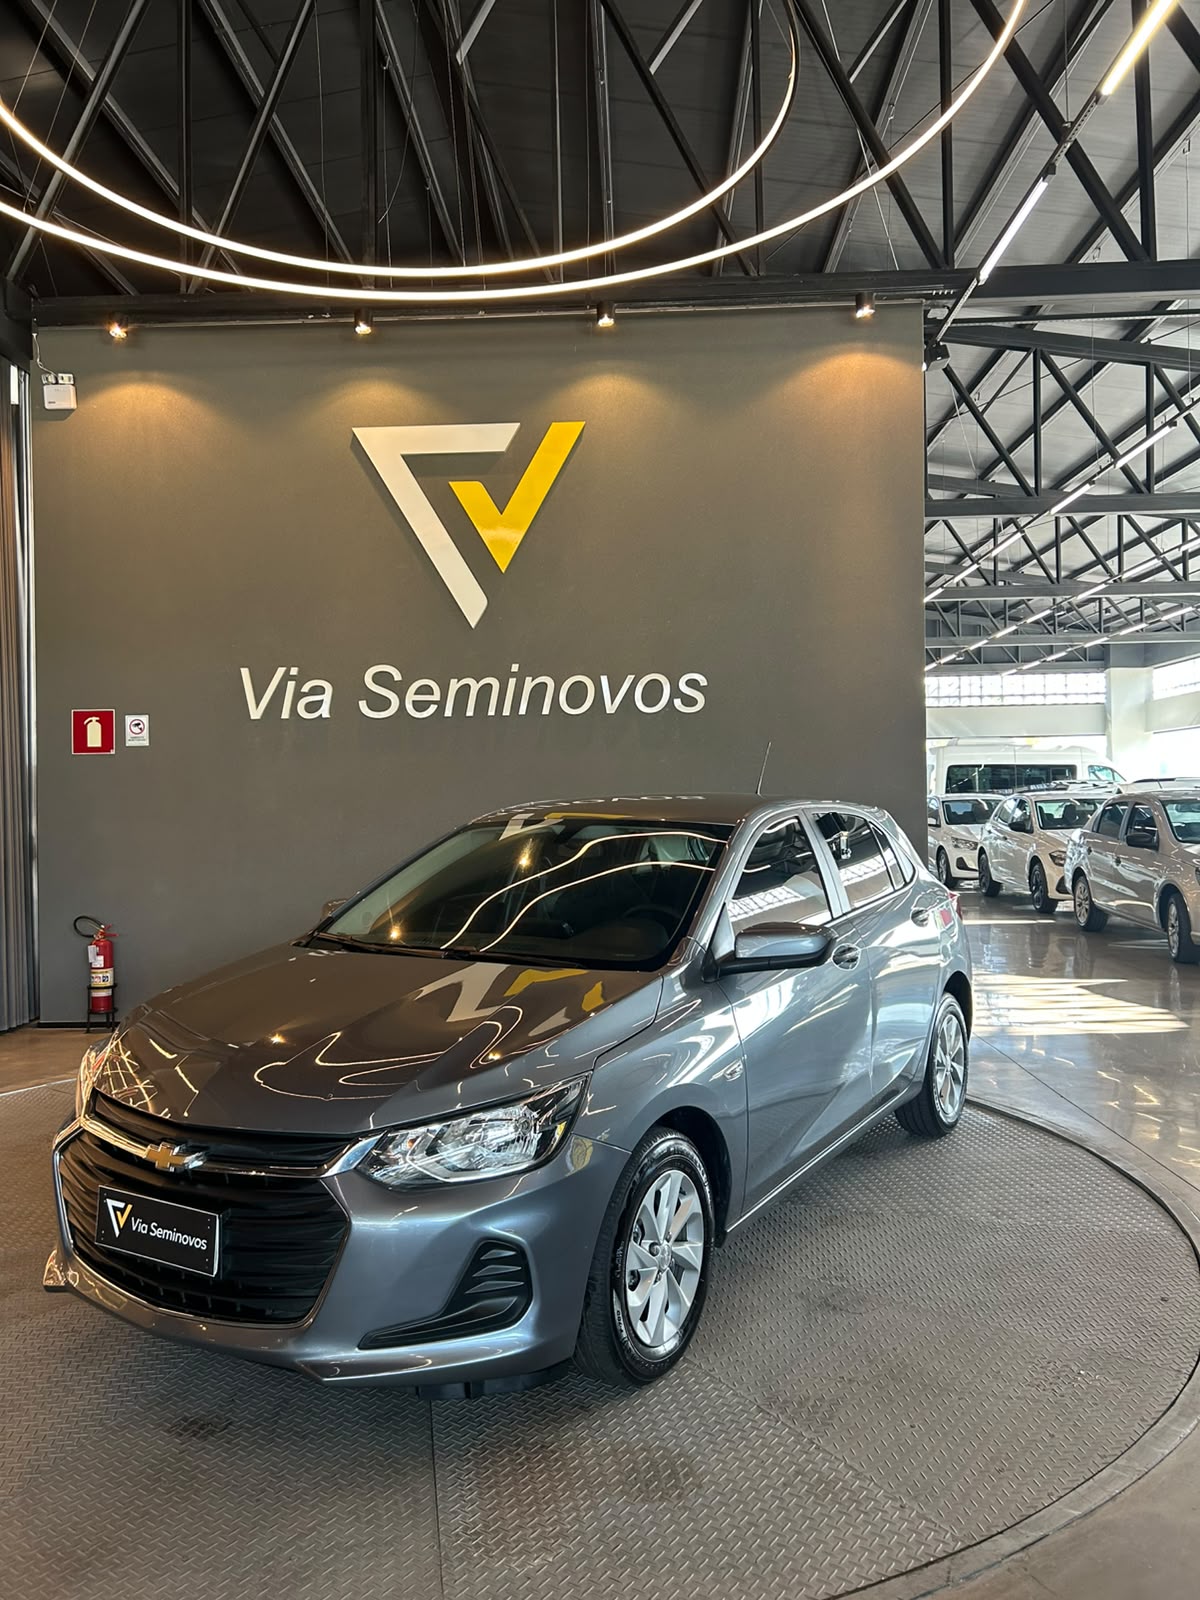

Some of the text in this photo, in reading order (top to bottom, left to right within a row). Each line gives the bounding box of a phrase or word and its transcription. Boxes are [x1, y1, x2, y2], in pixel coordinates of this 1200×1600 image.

[239, 662, 709, 720] Via Seminovos
[131, 1216, 208, 1250] Via Seminovos
